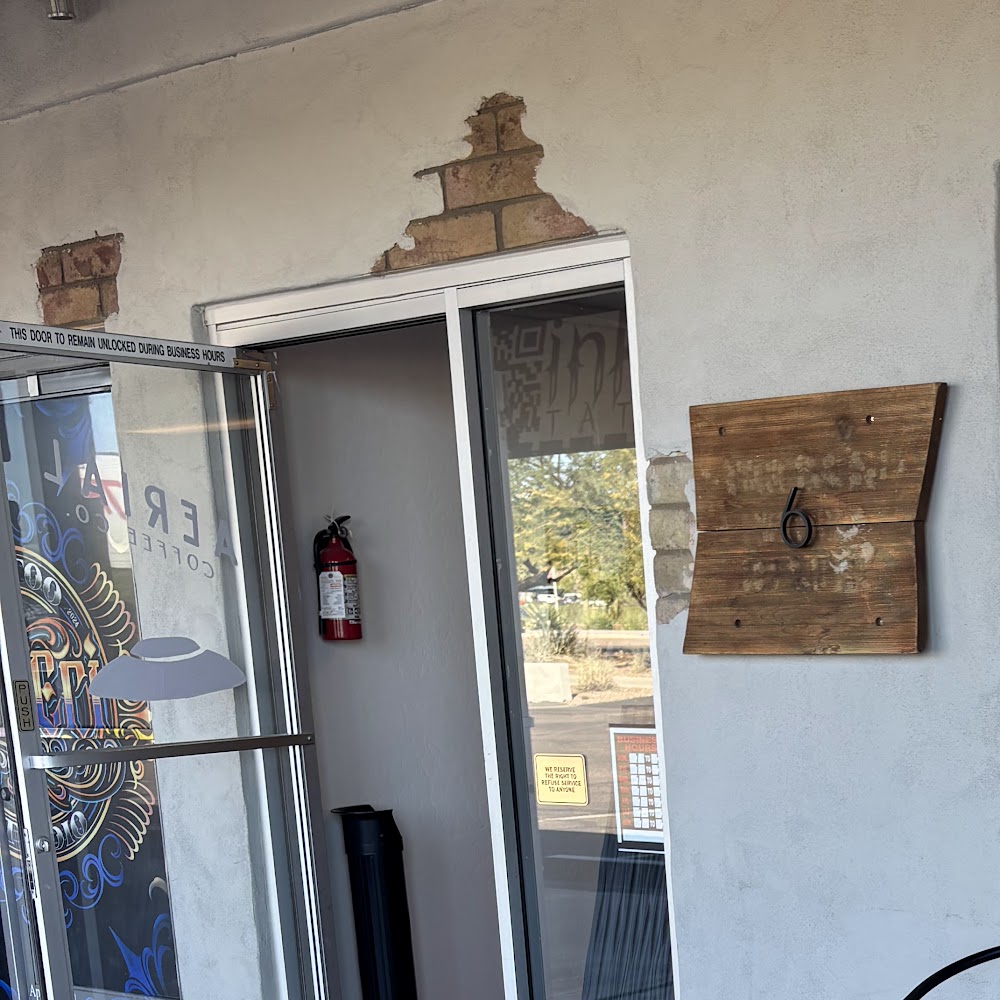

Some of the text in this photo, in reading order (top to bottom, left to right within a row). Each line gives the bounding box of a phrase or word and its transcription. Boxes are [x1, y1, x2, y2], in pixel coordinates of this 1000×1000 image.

[9, 327, 226, 363] THIS DOOR TO REMAIN UNLOCKED DURING BUSINESS HOURS
[780, 486, 812, 549] 6
[18, 684, 31, 728] PUSH
